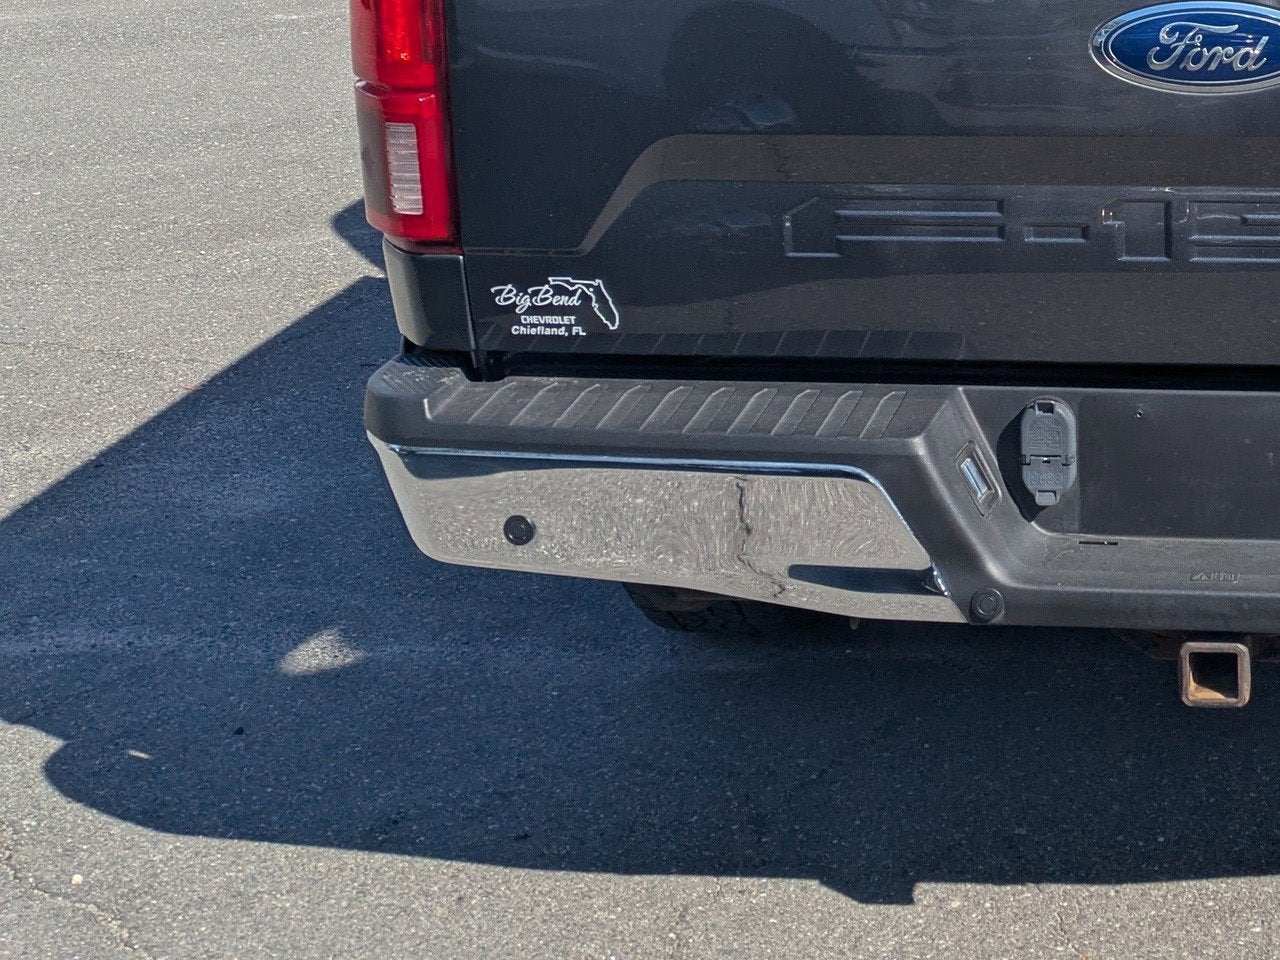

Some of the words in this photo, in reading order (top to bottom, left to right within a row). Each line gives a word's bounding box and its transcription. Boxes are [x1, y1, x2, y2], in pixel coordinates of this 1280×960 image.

[1146, 21, 1270, 72] Ford
[490, 283, 532, 314] Big
[527, 284, 582, 306] Bend
[520, 315, 577, 325] CHEVROLET
[511, 325, 569, 337] Chiefland,
[572, 326, 587, 336] FL
